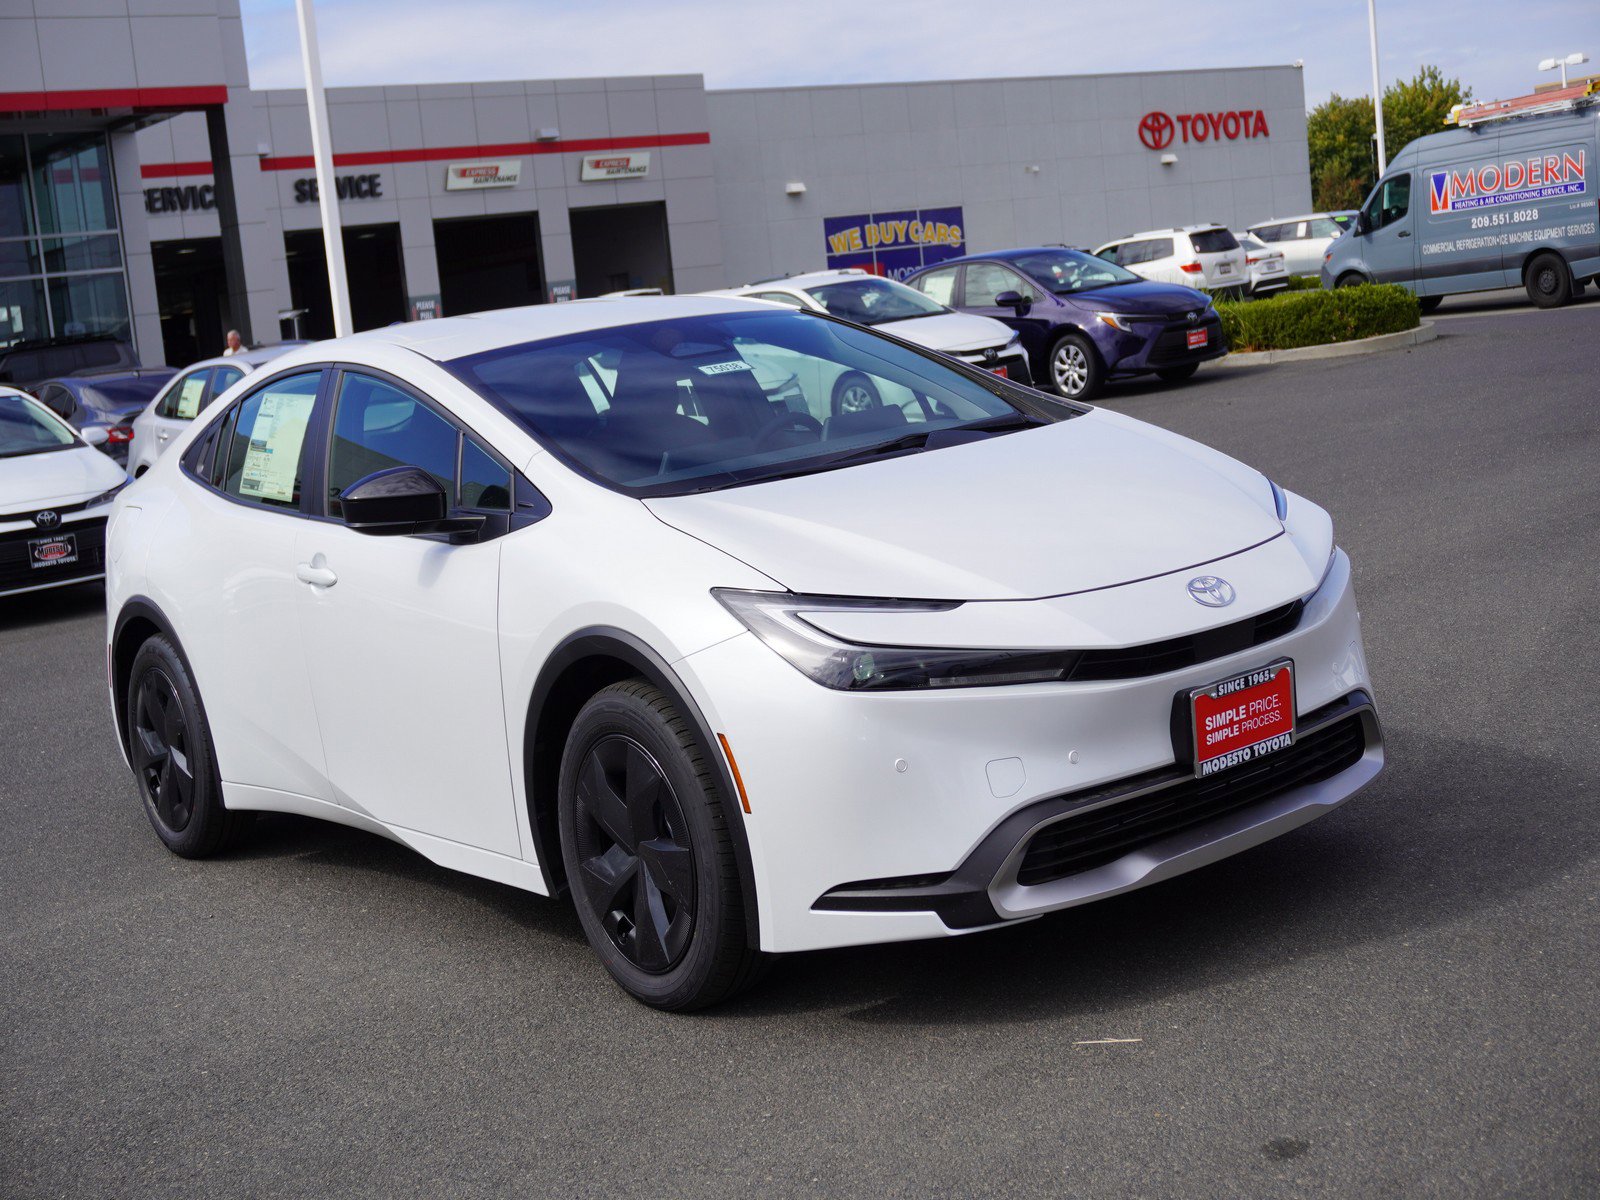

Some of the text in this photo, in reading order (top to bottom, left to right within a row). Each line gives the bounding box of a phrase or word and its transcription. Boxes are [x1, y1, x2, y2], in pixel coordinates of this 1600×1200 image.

[1177, 110, 1269, 143] TOYOTA
[466, 167, 497, 177] EXPRESS
[600, 158, 627, 168] EXPRESS
[606, 166, 647, 175] MAINTENANCE
[1451, 150, 1585, 199] MODERN
[294, 174, 383, 204] SEVICE
[473, 174, 517, 184] MAINTENANCE
[143, 185, 218, 213] ERVIC
[1455, 199, 1479, 209] HEATING
[1485, 197, 1494, 205] AIR
[1495, 190, 1540, 203] CONDITIONING
[1567, 184, 1580, 193] INC.
[1471, 209, 1539, 229] 209.551.8028
[828, 220, 962, 256] WE BUY CARS
[1422, 241, 1456, 255] COMMERCIAL
[1508, 231, 1533, 244] MACHINE
[1533, 226, 1566, 241] EQUIPMENT
[1566, 222, 1596, 237] SERVICES
[1218, 670, 1270, 696] SINCE 1965
[1205, 694, 1282, 731] SIMPLE PRICE.
[1206, 710, 1283, 745] SIMPLE PROCESS.
[1202, 733, 1292, 776] MODESTO TOYOTA
